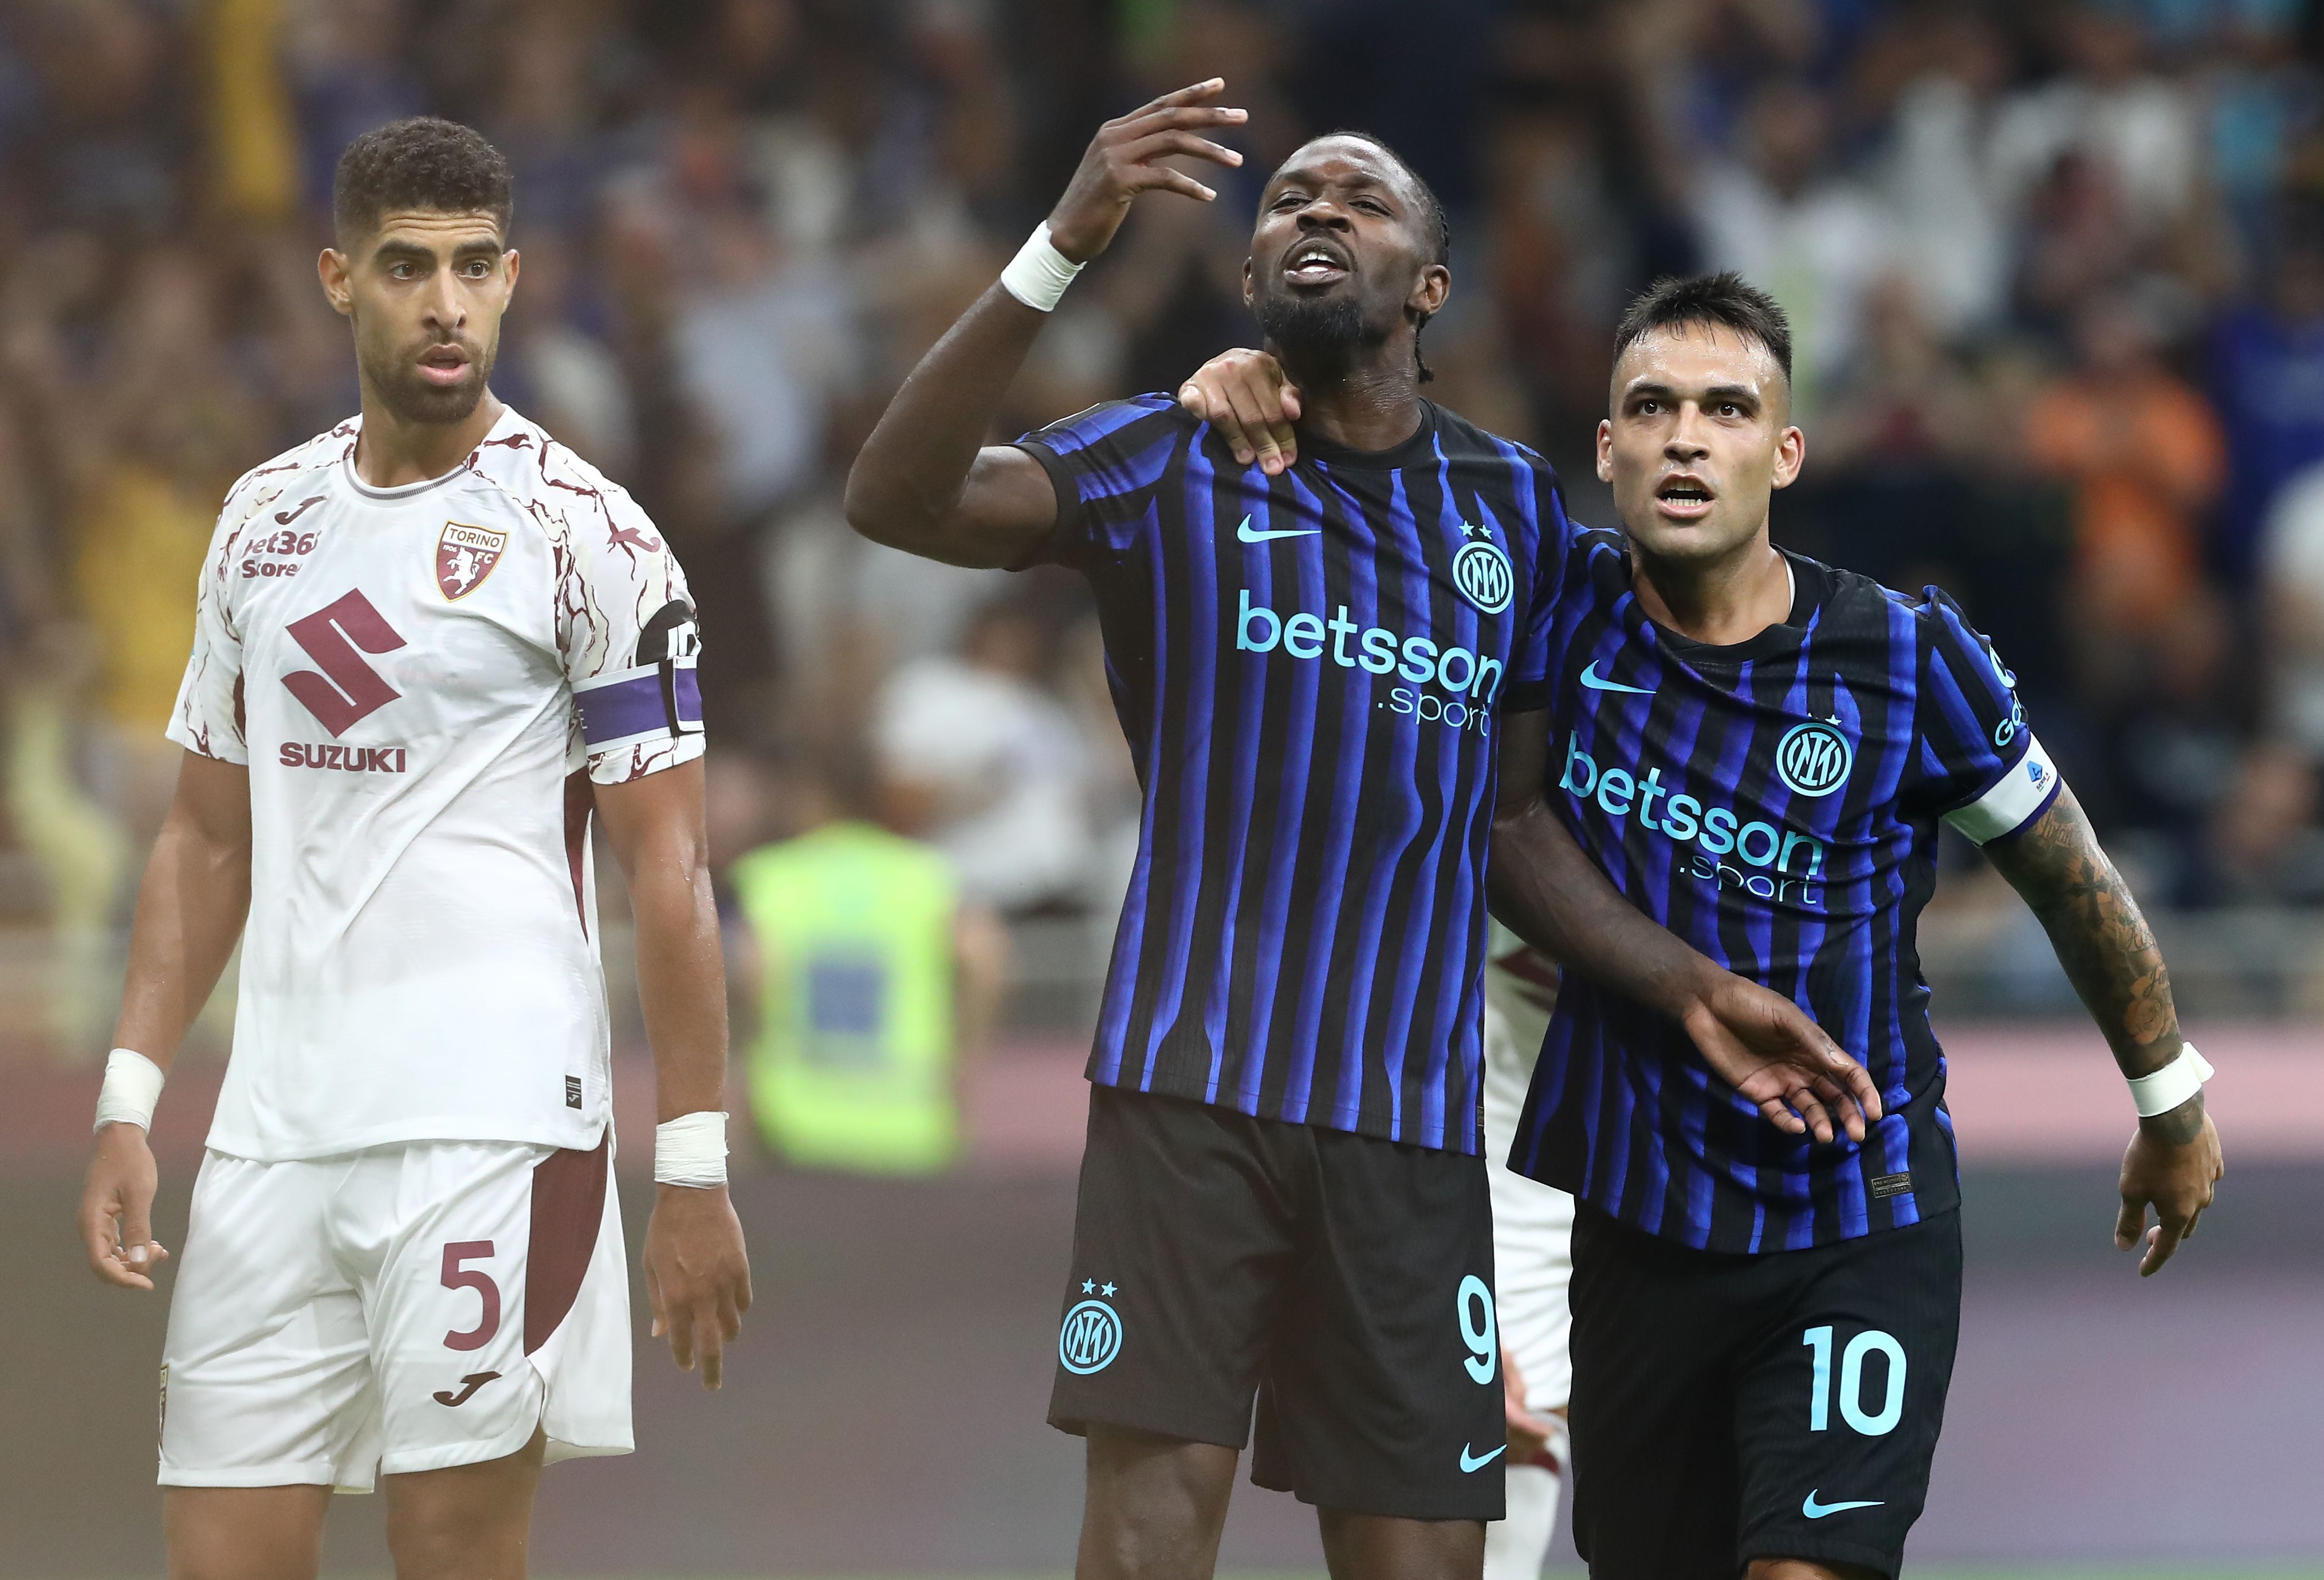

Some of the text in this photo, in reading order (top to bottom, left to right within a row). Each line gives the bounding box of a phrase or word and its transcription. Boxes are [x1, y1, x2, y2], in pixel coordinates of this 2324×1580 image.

[442, 544, 458, 552] 1906
[450, 528, 500, 548] TORINO
[474, 551, 495, 564] FC
[1236, 589, 1503, 703] betsson
[280, 742, 406, 773] SUZUKI
[2036, 775, 2047, 791] SERIE
[1558, 729, 1823, 876] betsson
[441, 1240, 501, 1351] 5
[1457, 1275, 1496, 1385] 9
[1803, 1325, 1908, 1436] 10
